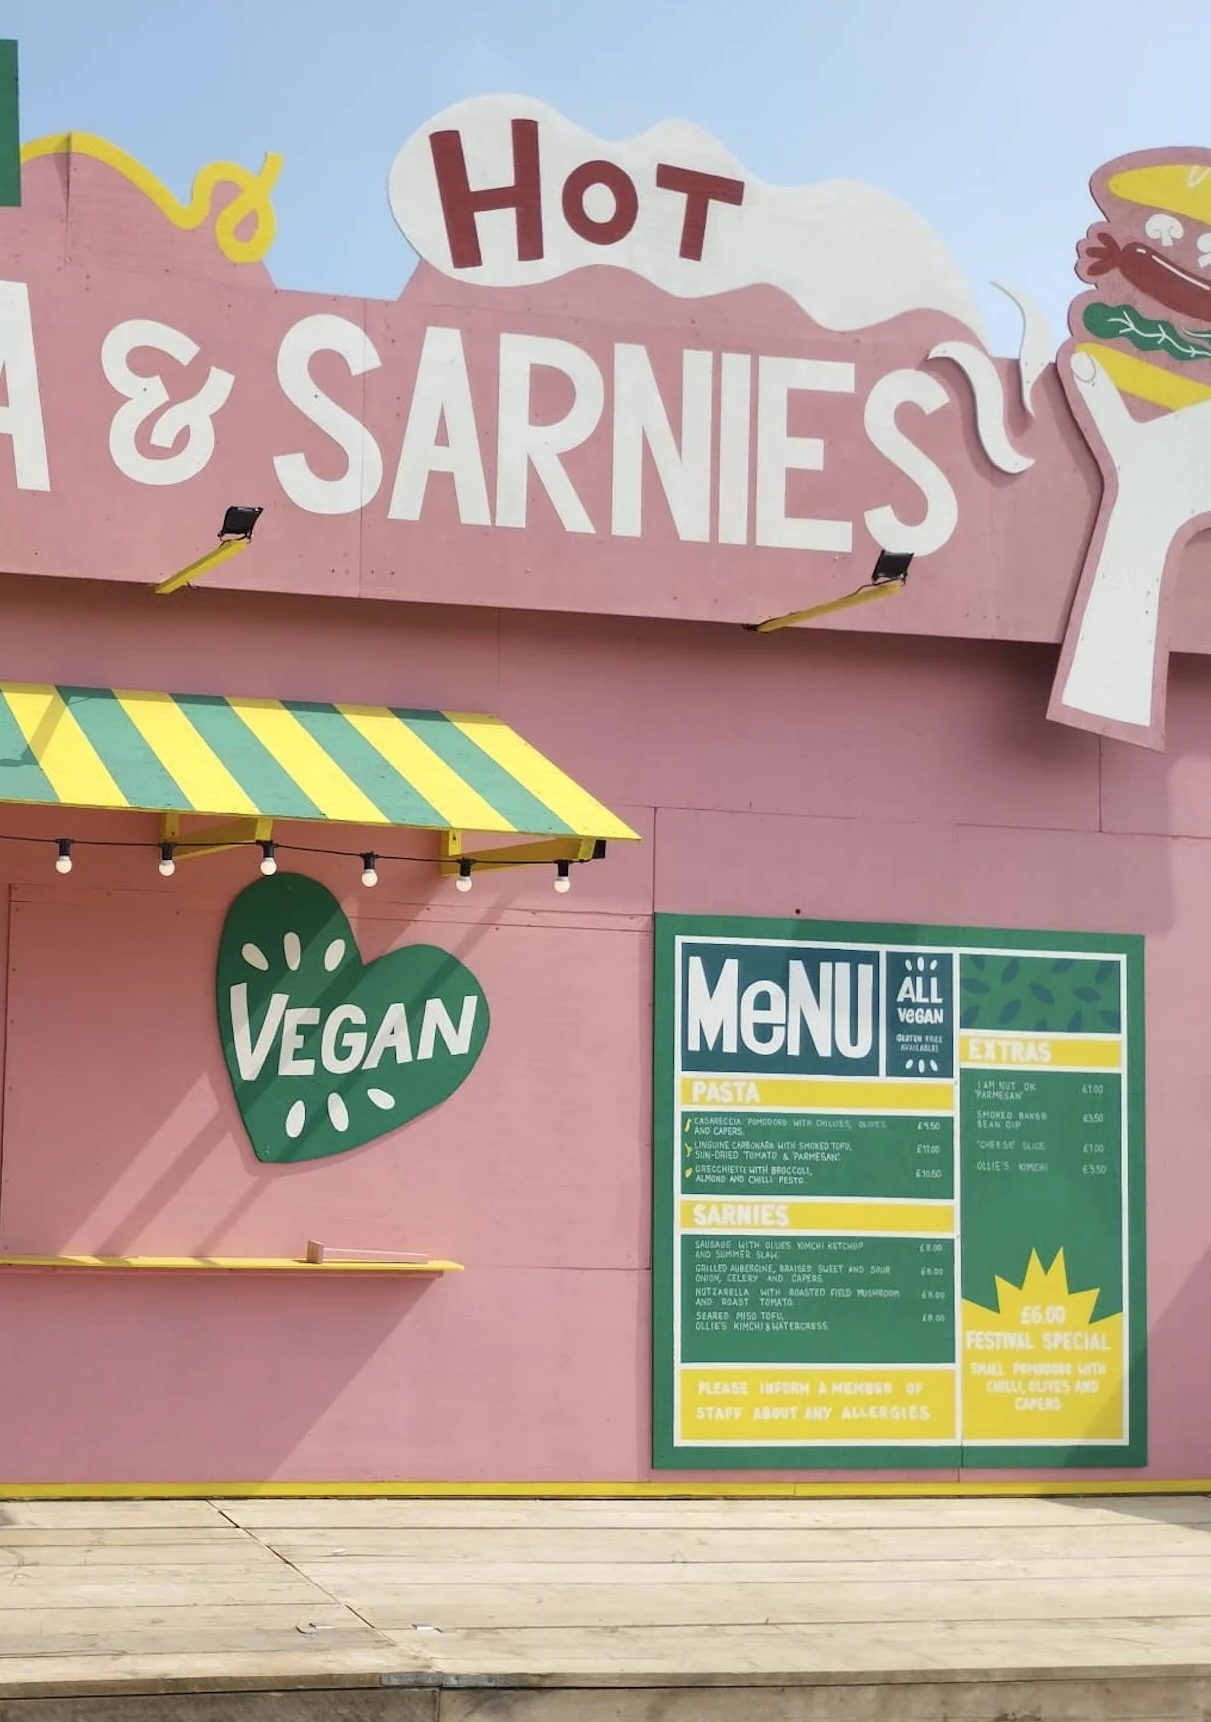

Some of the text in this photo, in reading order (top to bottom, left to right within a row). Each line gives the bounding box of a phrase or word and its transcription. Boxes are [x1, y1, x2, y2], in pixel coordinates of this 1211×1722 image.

[99, 317, 236, 488] &
[273, 313, 959, 558] SARNIES
[896, 976, 944, 1004] ALL
[688, 956, 873, 1059] MeNU
[230, 982, 478, 1081] VEGAN
[896, 1033, 943, 1043] GLUTEN FREE
[969, 1038, 1051, 1063] EXTRAS
[983, 1081, 1037, 1091] AM OK
[692, 1081, 760, 1104] PASTA
[977, 1110, 1047, 1120] SMOKED BAKED
[748, 1119, 787, 1127] POMODORO
[977, 1120, 1021, 1129] BEAN DIP
[694, 1142, 729, 1150] LINGUINE
[732, 1142, 774, 1150] CARBONARA
[799, 1142, 829, 1150] SMOKED
[1022, 1141, 1045, 1150] SLICE
[746, 1152, 777, 1160] TOMATO
[749, 1165, 768, 1174] WITH
[977, 1161, 1048, 1172] OLLIE'S KIMCHI
[748, 1176, 772, 1184] CHILLI
[693, 1204, 789, 1227] SARNIES
[695, 1241, 864, 1250] SAUSAGE WITH KIMCHI KETCHUP
[716, 1251, 750, 1259] SUMMER
[695, 1265, 891, 1274] GRILLED BRAISED SWEET AND SOUR
[789, 1289, 826, 1297] ROASTED
[831, 1289, 851, 1297] FIELD
[857, 1290, 900, 1298] MUSHROOM
[695, 1298, 749, 1306] AND ROAST
[696, 1312, 756, 1320] SEARED MISO
[1021, 1305, 1065, 1325] £6.00
[967, 1330, 1112, 1351] FESTIVAL SPECIAL
[970, 1362, 1005, 1375] SMALL
[1078, 1362, 1106, 1375] WITH
[698, 1380, 924, 1395] PLEASE INFORM A MEMBER OF
[1028, 1380, 1099, 1394] OLIVES AND
[1015, 1397, 1061, 1411] CAPERS
[696, 1406, 930, 1420] STAFF ABOUT ANY ALLERGIES
